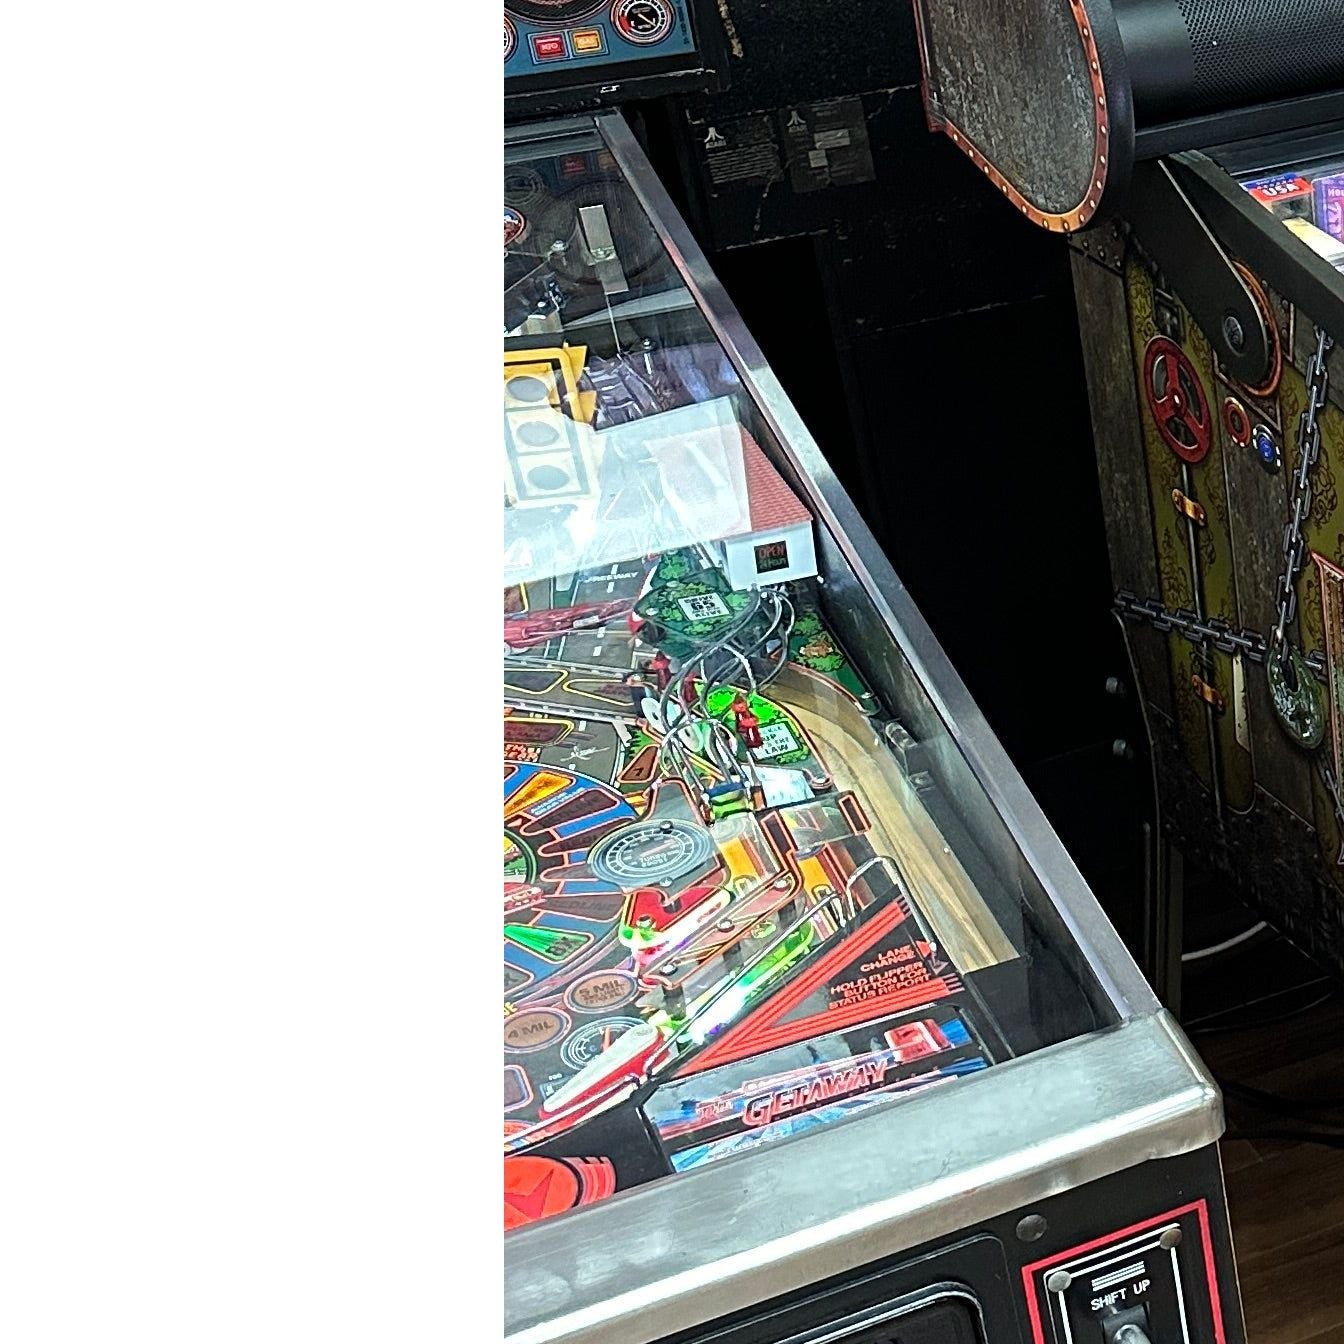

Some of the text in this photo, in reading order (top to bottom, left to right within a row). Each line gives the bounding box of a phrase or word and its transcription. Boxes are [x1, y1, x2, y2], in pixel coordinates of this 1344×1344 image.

[1263, 182, 1301, 197] USA
[860, 950, 916, 972] CHANGE
[878, 944, 913, 960] LANE
[828, 974, 932, 1010] STATUS REPORT
[830, 961, 924, 994] HOLD FLIPPER
[843, 967, 928, 998] BUTTON FOR
[520, 1021, 554, 1038] MIL
[742, 1060, 888, 1127] GETAWAY
[1091, 1279, 1151, 1311] SHIFT UP
